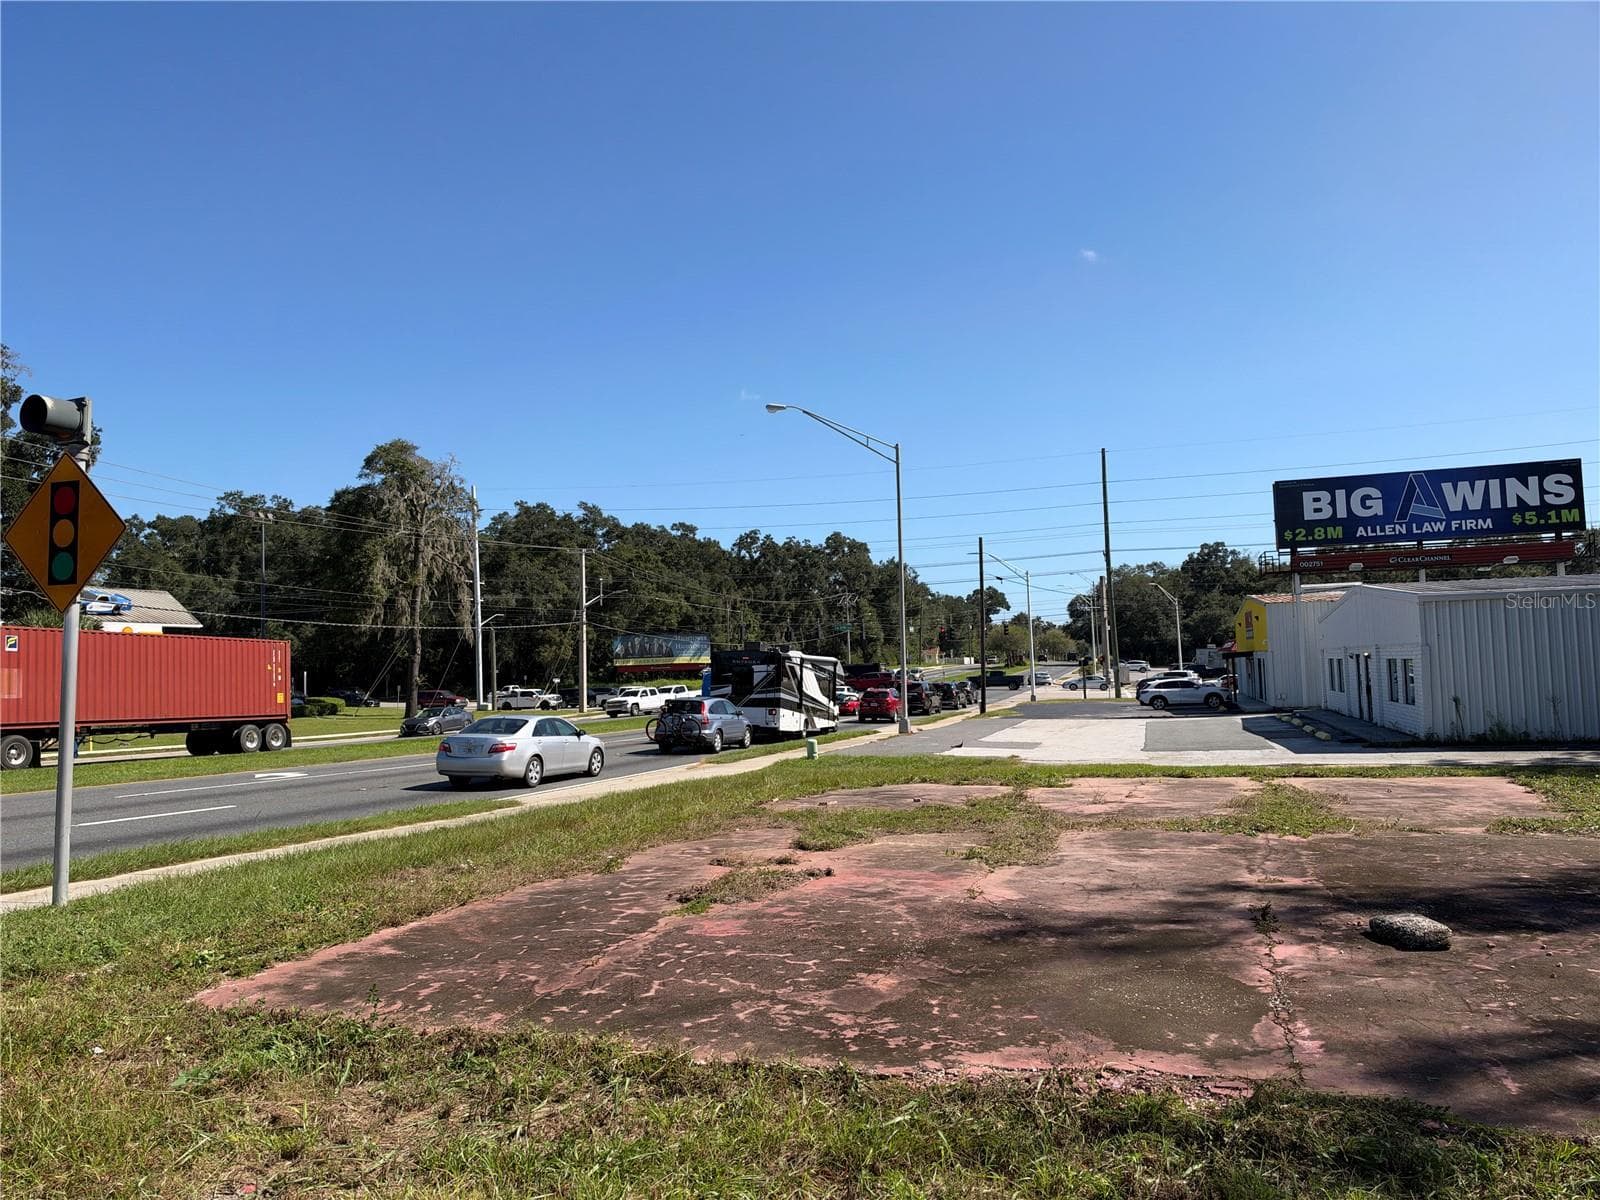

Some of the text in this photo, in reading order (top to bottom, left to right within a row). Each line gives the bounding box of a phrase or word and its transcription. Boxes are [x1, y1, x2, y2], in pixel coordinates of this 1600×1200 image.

[1302, 486, 1384, 520] BIG
[1441, 473, 1576, 512] WINS
[1512, 508, 1580, 526] $5.1M
[1283, 525, 1343, 542] $2.8M
[1356, 517, 1493, 537] ALLEN LAW FIRM
